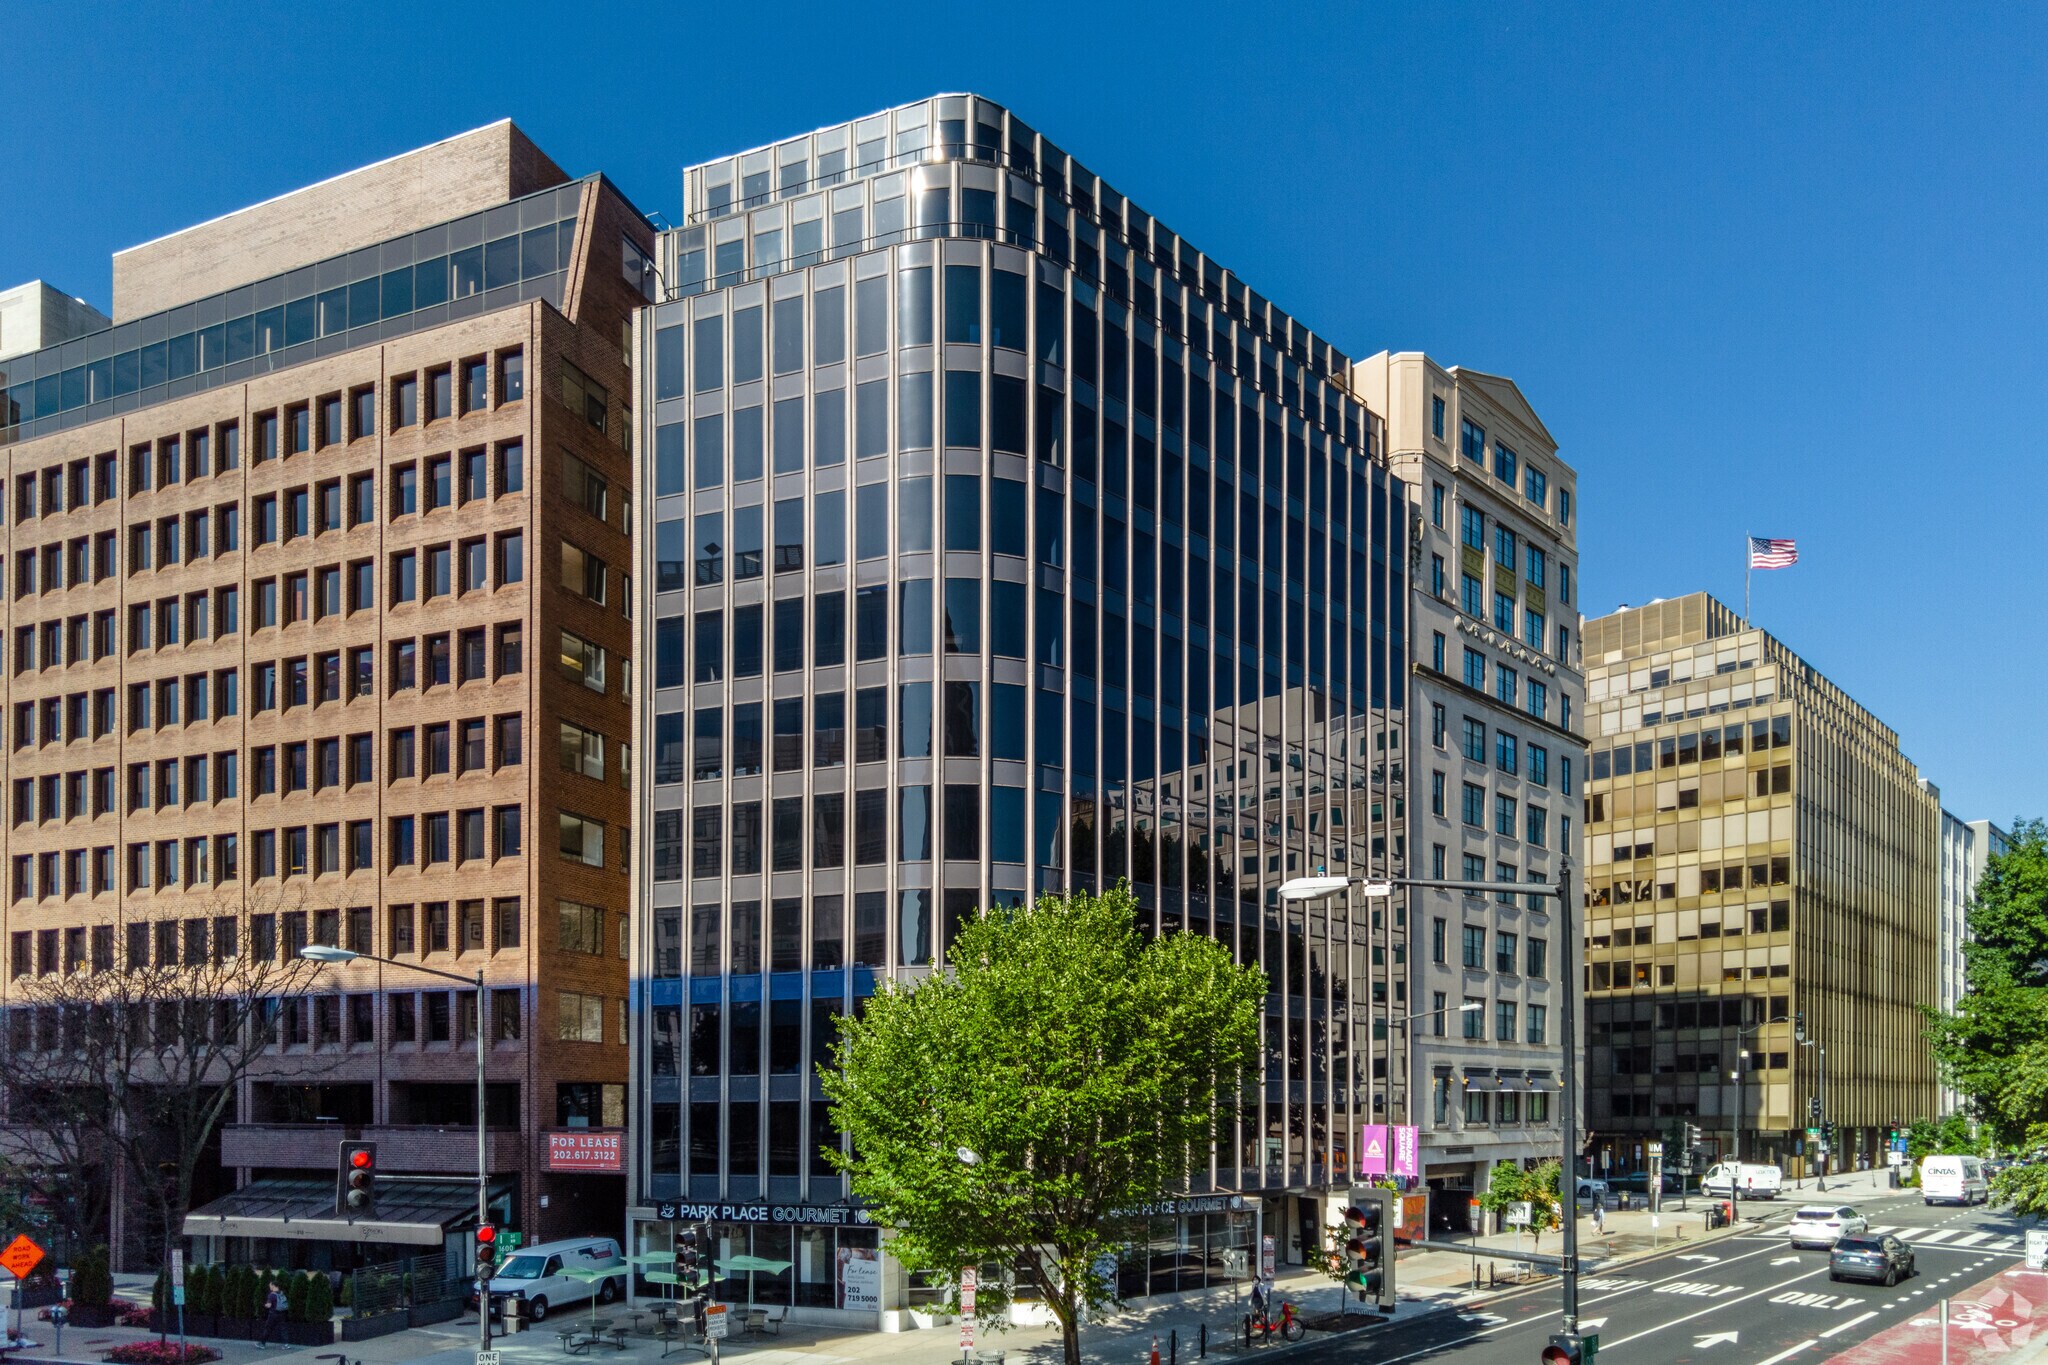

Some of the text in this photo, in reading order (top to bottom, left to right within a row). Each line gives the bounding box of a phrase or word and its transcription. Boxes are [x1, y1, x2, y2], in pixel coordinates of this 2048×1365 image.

[552, 1137, 618, 1148] FOR LEASE
[1398, 1127, 1406, 1161] SQUARE
[1405, 1127, 1413, 1172] FARRAGUT
[553, 1150, 616, 1160] 202.617.3122
[1178, 1196, 1228, 1213] GOURMET
[681, 1205, 850, 1223] PARK PLACE GOURMET
[11, 1260, 33, 1268] AHEAD
[847, 1286, 861, 1294] 202
[1561, 1279, 1650, 1291] ONLY
[1652, 1282, 1745, 1298] ONLY
[847, 1294, 878, 1303] 719 5000
[1768, 1291, 1866, 1311] ONLY
